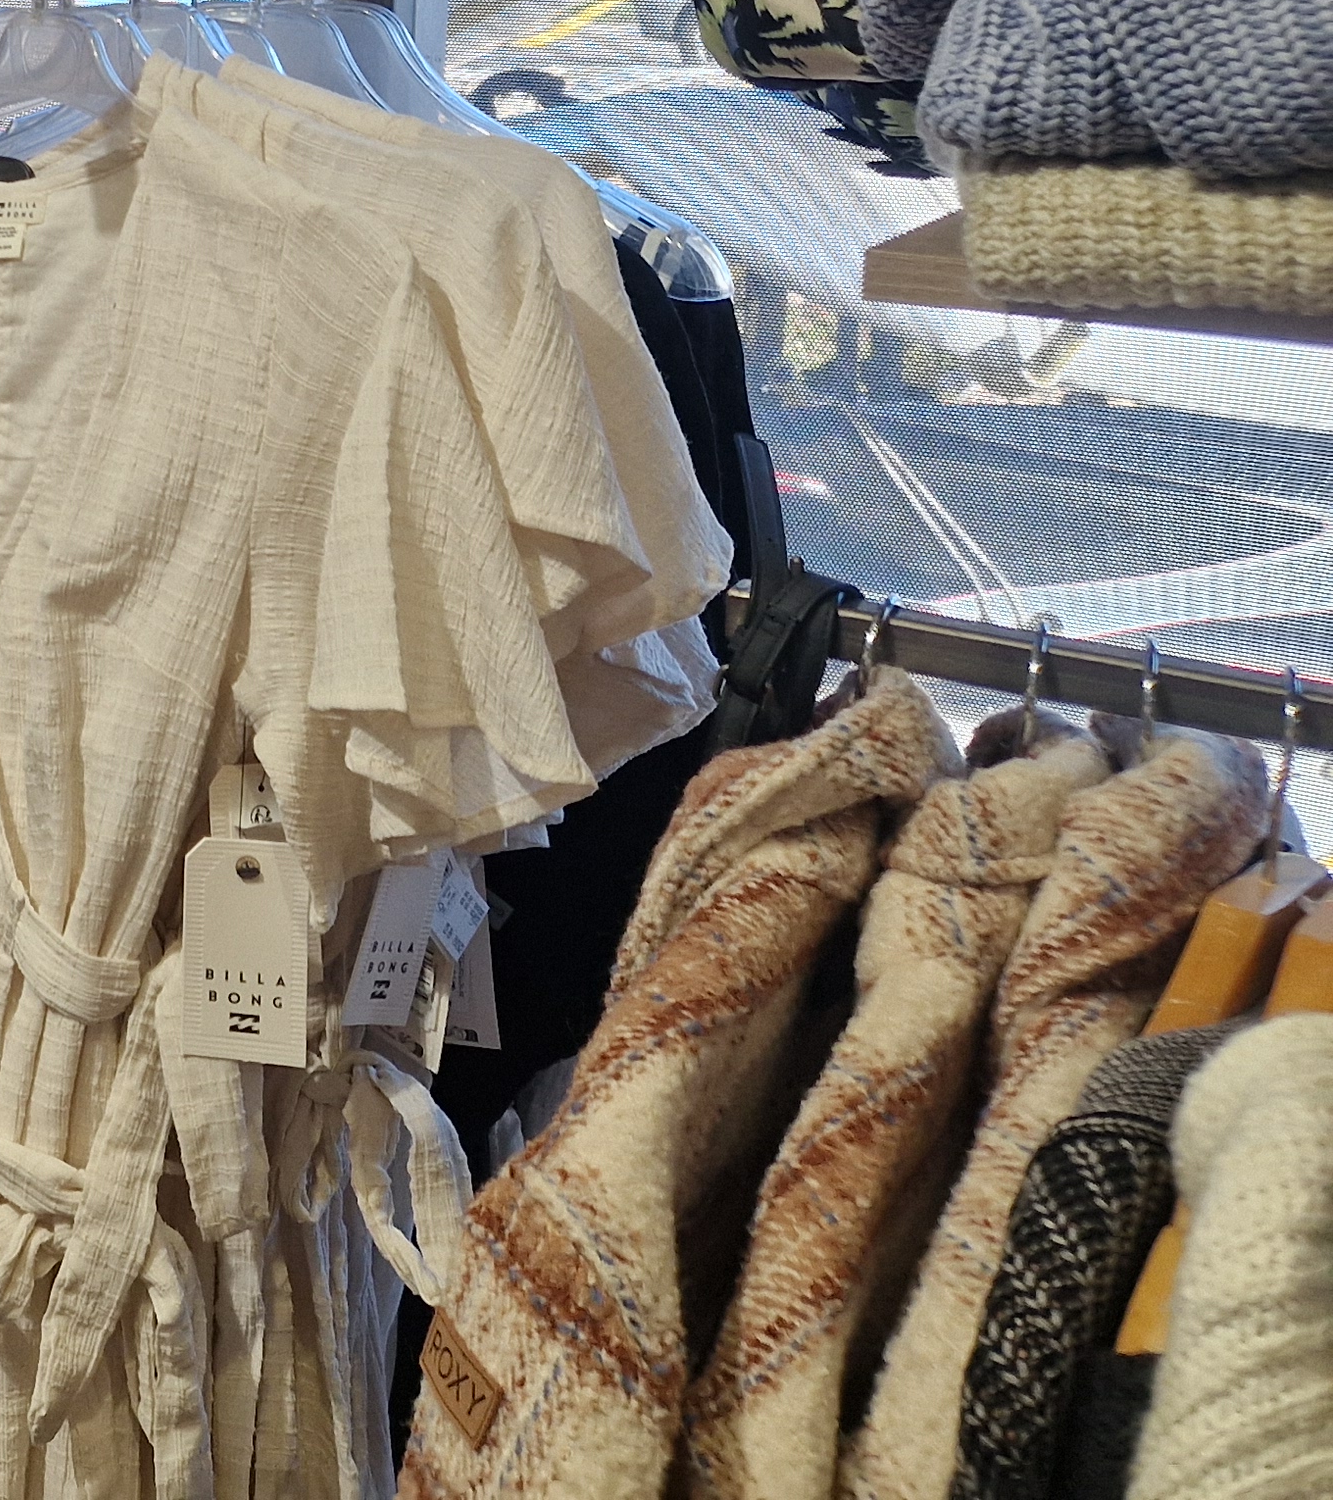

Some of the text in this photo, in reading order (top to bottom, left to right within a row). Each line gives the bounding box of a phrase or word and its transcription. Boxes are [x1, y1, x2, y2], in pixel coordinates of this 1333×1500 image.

[370, 940, 416, 954] BILLA
[367, 960, 410, 974] BONG
[205, 968, 287, 988] BILLA
[208, 989, 284, 1010] BONG
